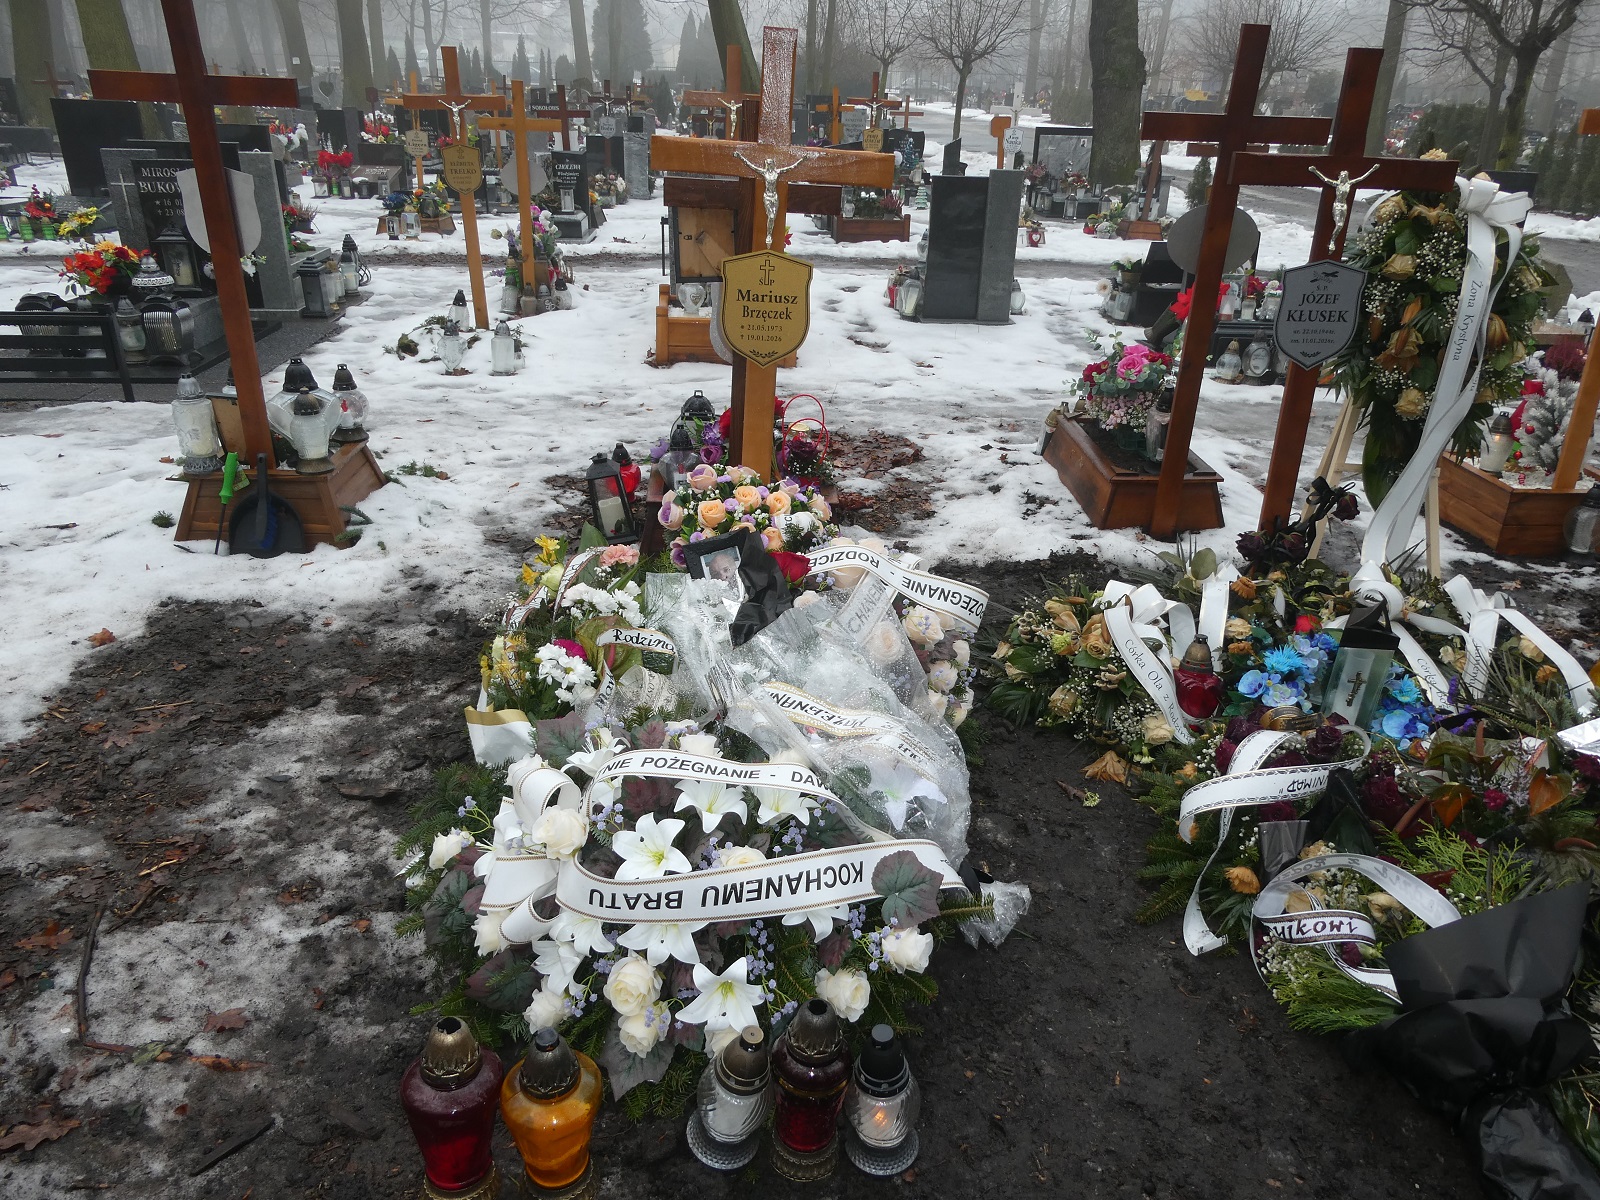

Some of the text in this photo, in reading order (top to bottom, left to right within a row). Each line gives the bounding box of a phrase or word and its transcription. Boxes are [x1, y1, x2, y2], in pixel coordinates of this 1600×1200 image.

[141, 167, 180, 178] MIROS
[736, 288, 798, 305] Mariusz
[1298, 291, 1340, 306] JÓZEF
[741, 305, 793, 322] Brzęczek
[1286, 309, 1349, 323] KŁUSEK
[747, 324, 783, 332] 21.05.1973
[747, 334, 783, 342] 19.01.2026
[1452, 314, 1474, 361] Krystyna
[809, 550, 880, 569] RODZICE
[1125, 638, 1146, 669] Córka
[1147, 670, 1164, 691] Ola
[769, 691, 870, 729] POŻEGNAN
[640, 755, 761, 780] POŻEGNANIE
[589, 860, 864, 911] KOCHANEMU BRATU
